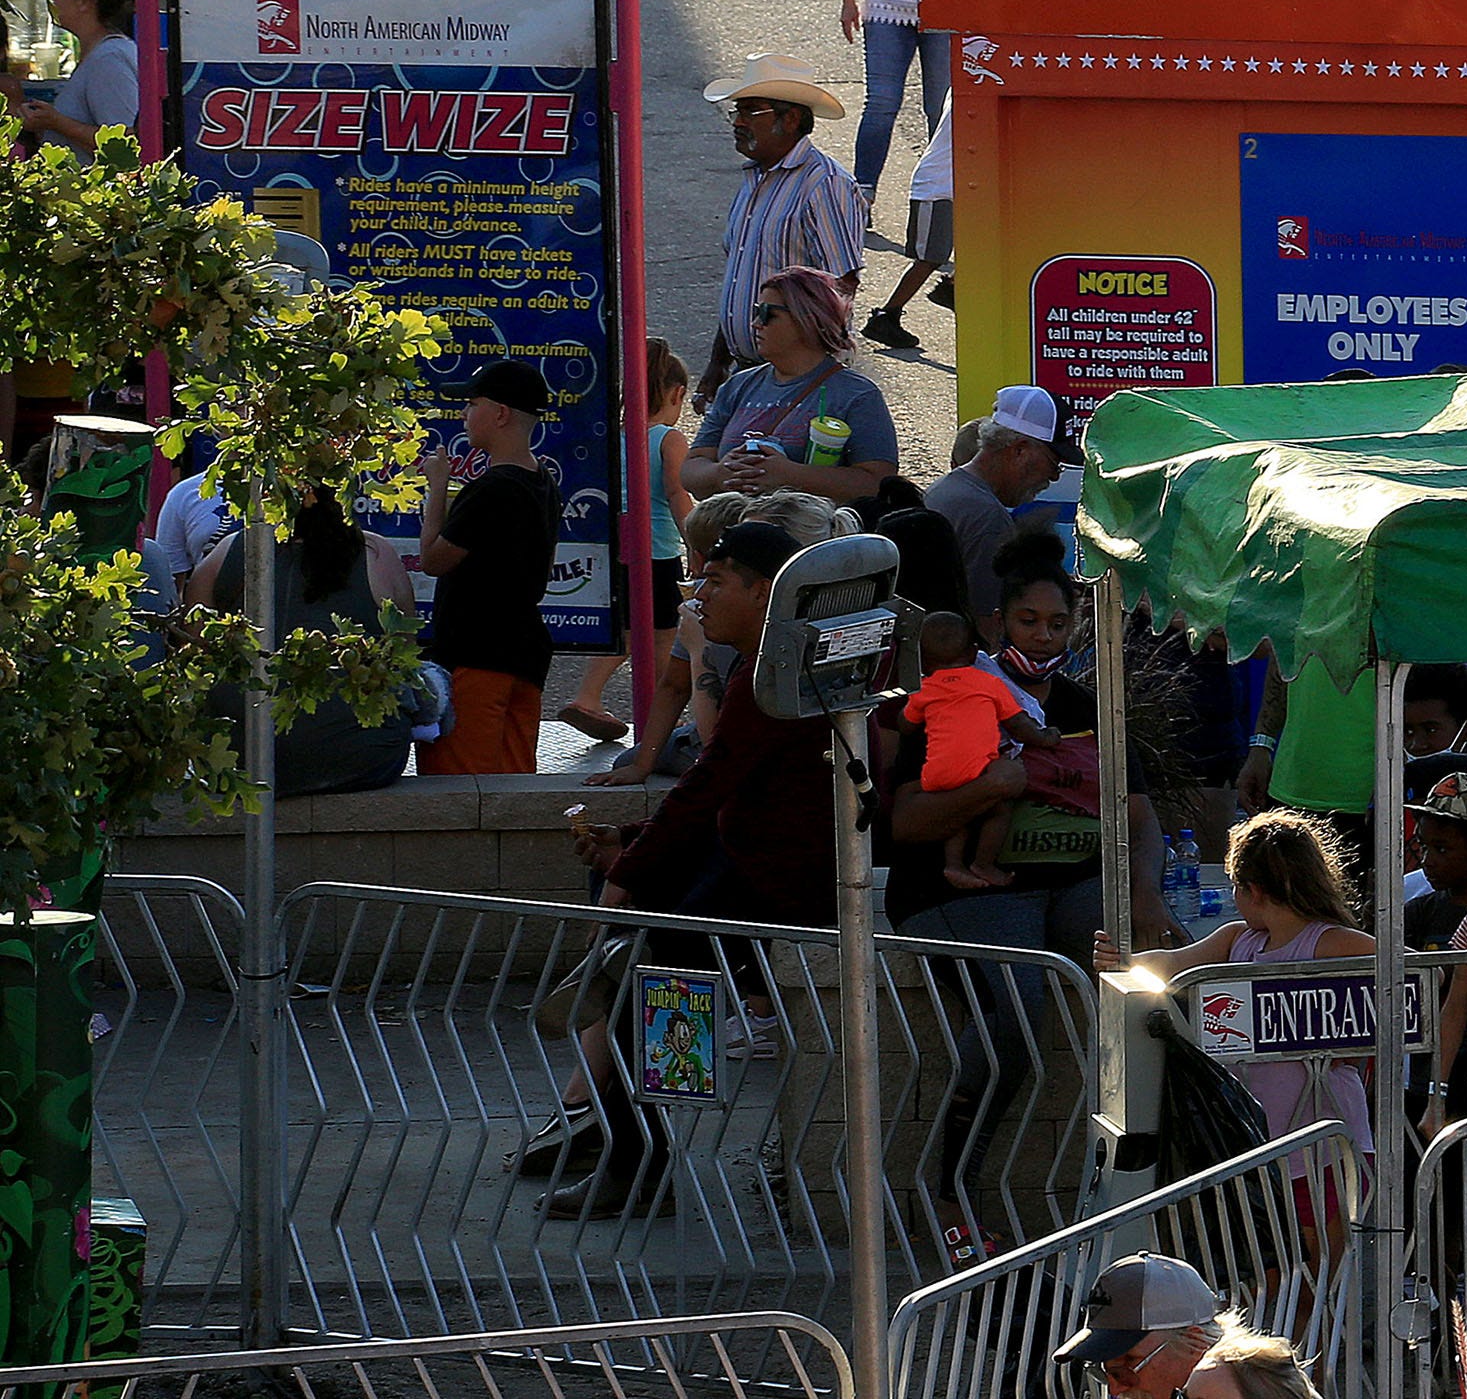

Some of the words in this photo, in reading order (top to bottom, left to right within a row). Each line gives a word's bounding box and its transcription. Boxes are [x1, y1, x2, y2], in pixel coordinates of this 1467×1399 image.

[306, 15, 359, 40] NORTH
[363, 16, 442, 41] AMERICAN
[447, 17, 511, 42] MIDWAY
[307, 46, 511, 57] ENTERTAINMENT
[196, 87, 370, 152] SIZE
[380, 89, 575, 155] WIZE
[1244, 138, 1258, 159] 2
[348, 178, 391, 194] Rides
[396, 179, 433, 194] have
[452, 179, 525, 196] minimum
[530, 181, 580, 199] height
[349, 198, 450, 217] requirement,
[454, 200, 504, 218] please
[509, 202, 574, 216] measure
[350, 219, 386, 234] your
[390, 216, 429, 231] child
[453, 218, 523, 234] advance.
[348, 244, 370, 259] All
[375, 244, 419, 260] riders
[424, 245, 475, 260] MUST
[479, 246, 517, 261] have
[521, 247, 573, 263] tickets
[370, 263, 454, 279] wristbands
[478, 265, 520, 280] order
[546, 265, 582, 282] ride.
[1079, 272, 1168, 296] NOTICE
[401, 292, 437, 307] rides
[443, 294, 498, 311] require
[524, 293, 569, 310] adult
[1047, 308, 1068, 322] All
[1071, 309, 1127, 324] children
[1131, 311, 1171, 324] under
[1047, 327, 1070, 341] tall
[1074, 330, 1102, 345] may
[1127, 329, 1185, 346] required
[467, 341, 505, 356] have
[510, 343, 589, 357] maximum
[1043, 345, 1076, 359] have
[1091, 347, 1169, 363] responsible
[1172, 347, 1209, 363] adult
[1328, 331, 1420, 362] ONLY
[1086, 363, 1114, 378] ride
[1116, 364, 1147, 380] with
[1149, 365, 1185, 380] them
[1012, 829, 1099, 853] HISTOR
[1257, 984, 1419, 1043] ENTRANE
